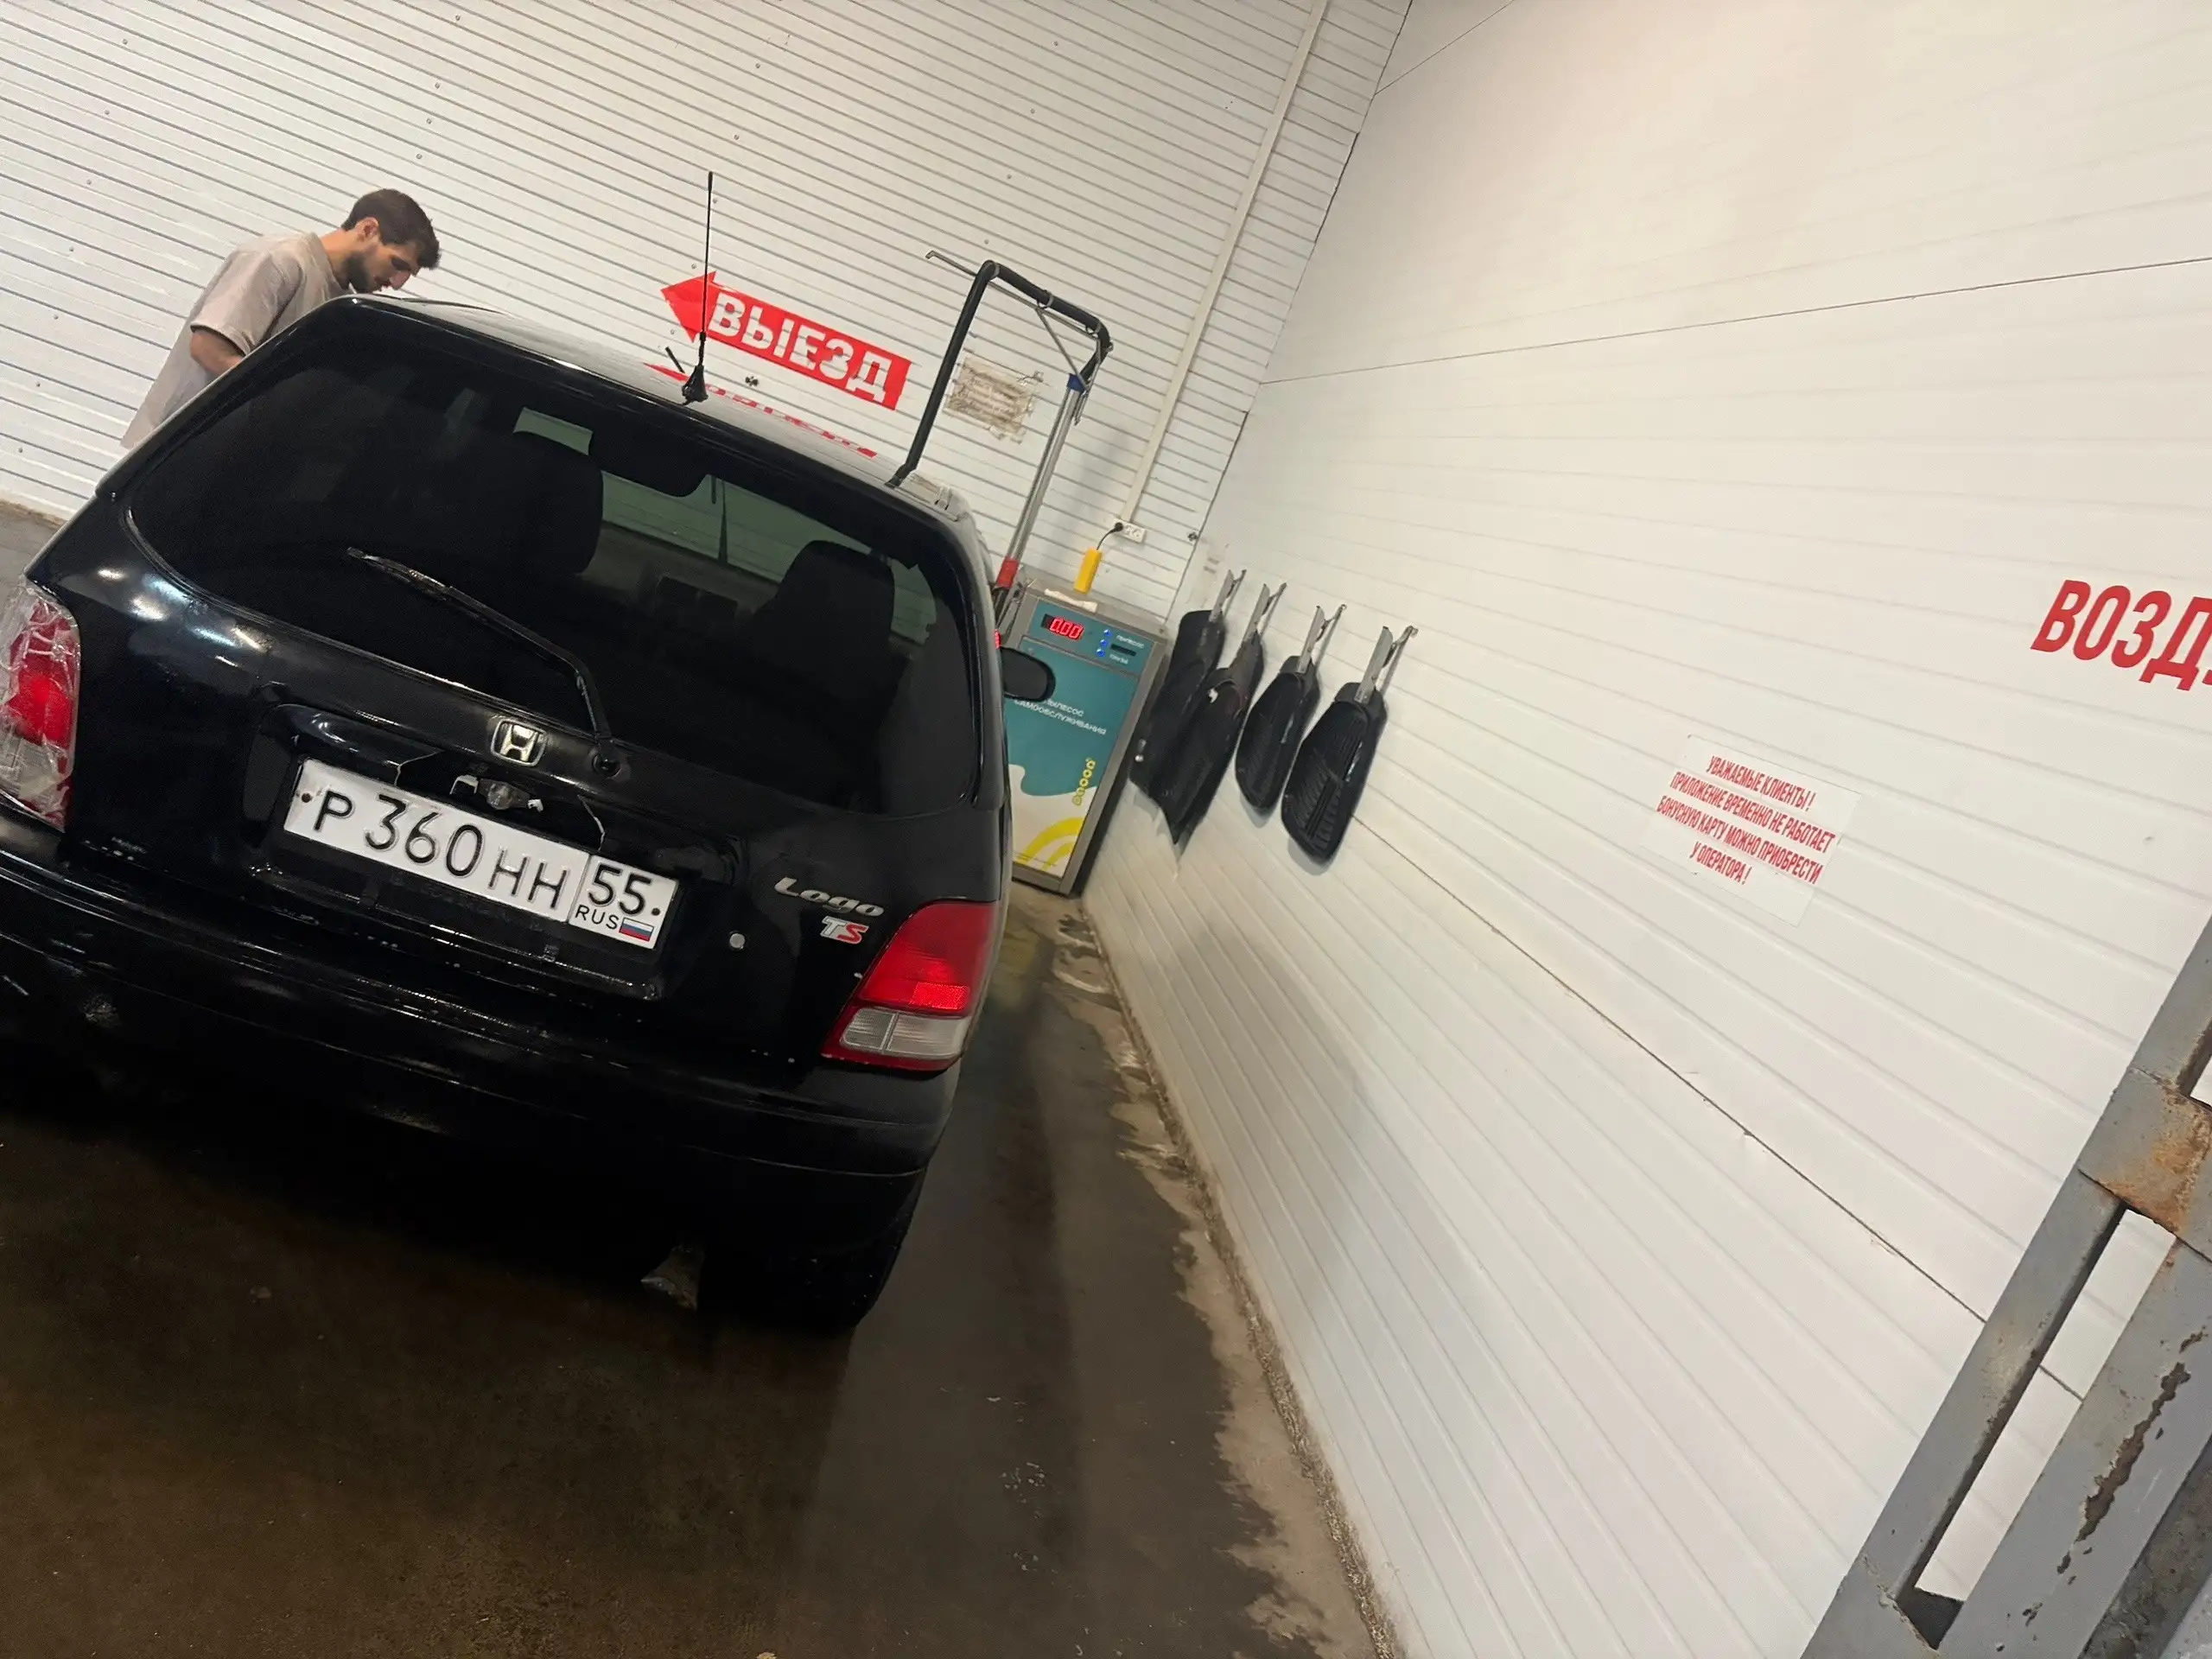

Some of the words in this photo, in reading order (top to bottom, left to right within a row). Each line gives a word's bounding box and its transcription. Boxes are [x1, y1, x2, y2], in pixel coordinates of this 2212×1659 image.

[708, 291, 893, 404] ВЫЕЗД
[2031, 579, 2212, 691] ВОЗД
[1707, 755, 1764, 792] УВАЖАЕМЫЕ
[1669, 771, 1725, 808] ПРИЛОЖЕНИЕ
[1723, 793, 1773, 830] ВРЕМЕННО
[1769, 810, 1788, 835] НЕ
[1782, 817, 1836, 854] РАБОТАЕТ
[1656, 795, 1702, 829] БОНУСНУЮ
[1697, 815, 1729, 842] КАРТУ
[1724, 825, 1763, 856] МОЖНО
[1757, 841, 1823, 885] ПРИОБРЕСТИ
[1689, 841, 1702, 859] У
[588, 864, 653, 915] 55
[774, 877, 884, 916] Logo
[575, 905, 620, 931] RUS
[819, 916, 870, 945] TS
